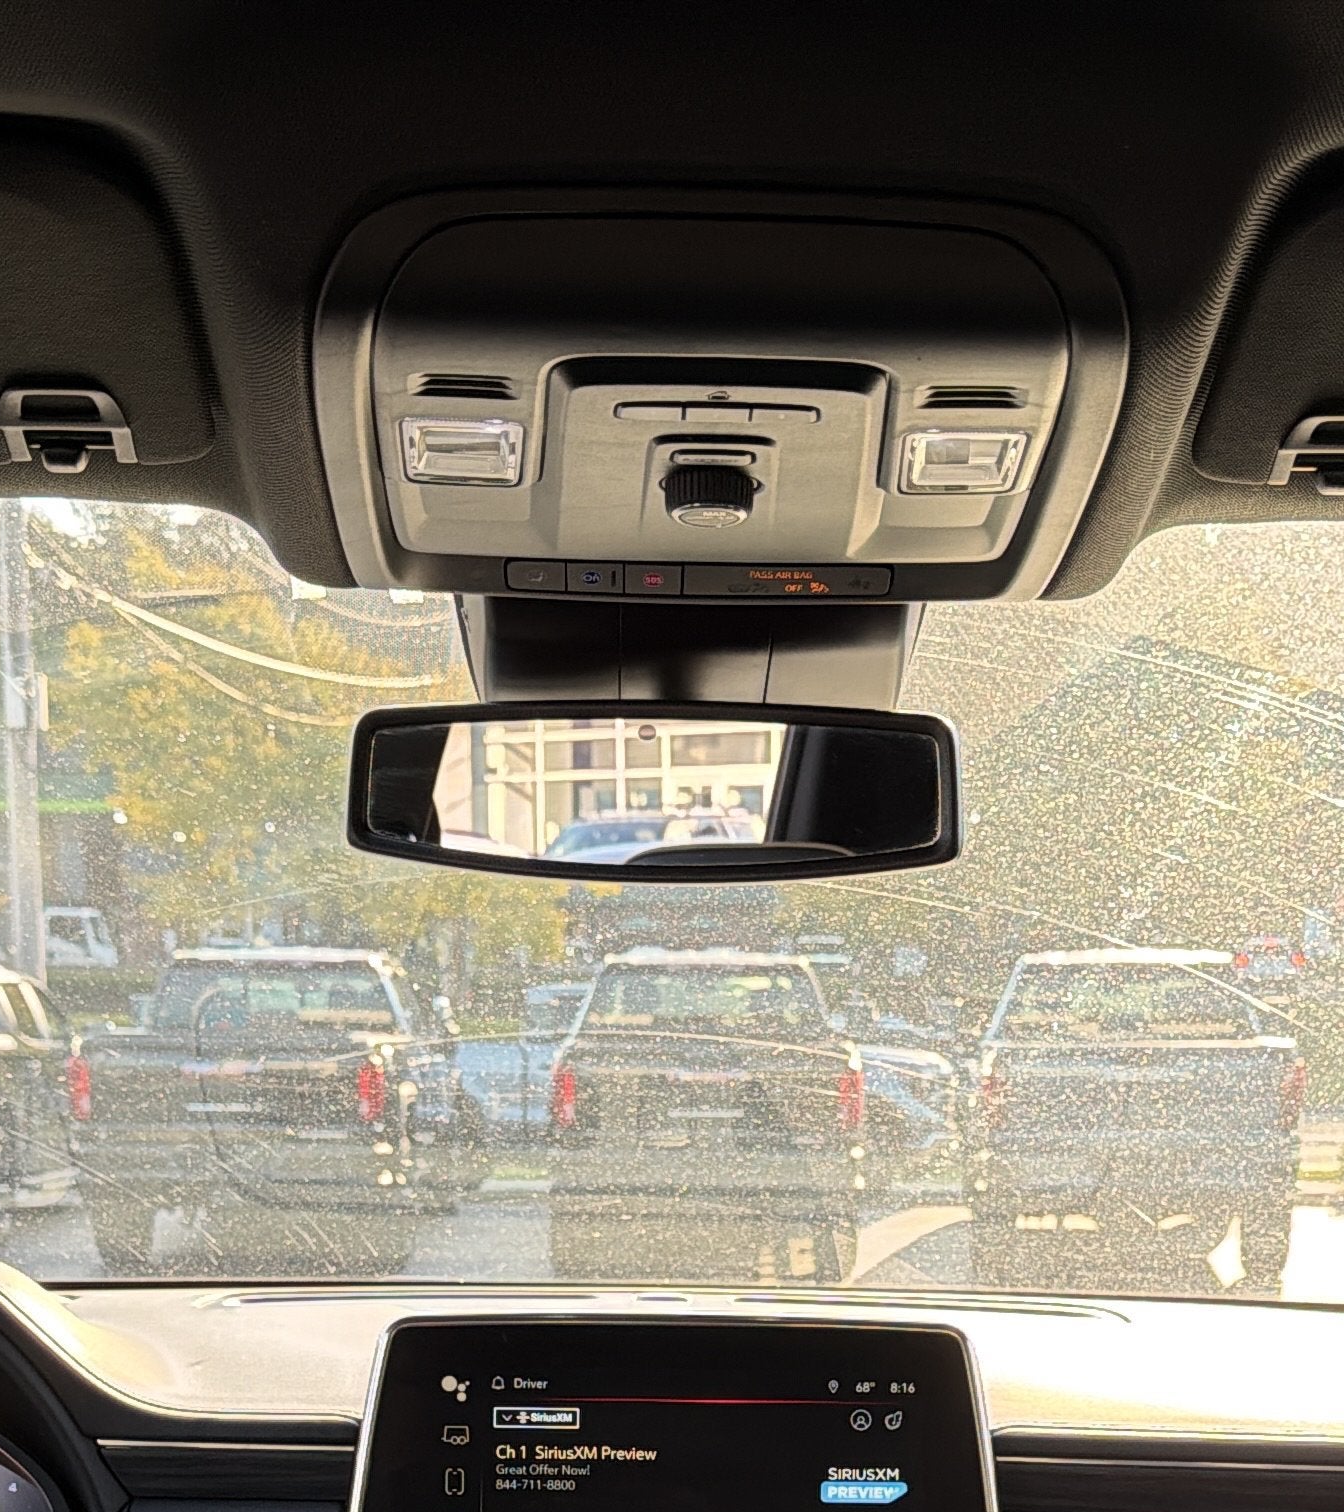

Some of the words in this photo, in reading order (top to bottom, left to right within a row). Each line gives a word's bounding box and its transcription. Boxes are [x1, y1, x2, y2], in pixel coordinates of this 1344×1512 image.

[750, 570, 773, 579] PASS
[775, 571, 792, 579] AIR
[793, 571, 813, 580] BAG
[785, 584, 804, 593] OFF
[513, 1378, 548, 1390] Driver
[890, 1382, 916, 1395] 8:16
[530, 1412, 573, 1424] SiriusXM
[495, 1445, 517, 1460] Ch
[520, 1446, 527, 1460] 1
[535, 1446, 598, 1460] SiriusXM
[601, 1447, 657, 1461] Preview
[496, 1464, 527, 1476] Great
[529, 1464, 560, 1476] Offer
[562, 1464, 591, 1476] Now!
[828, 1467, 900, 1481] SIRIUSXM
[8, 1482, 18, 1493] 4
[495, 1479, 576, 1491] 844-711-8800
[827, 1485, 898, 1499] PREVIEW
